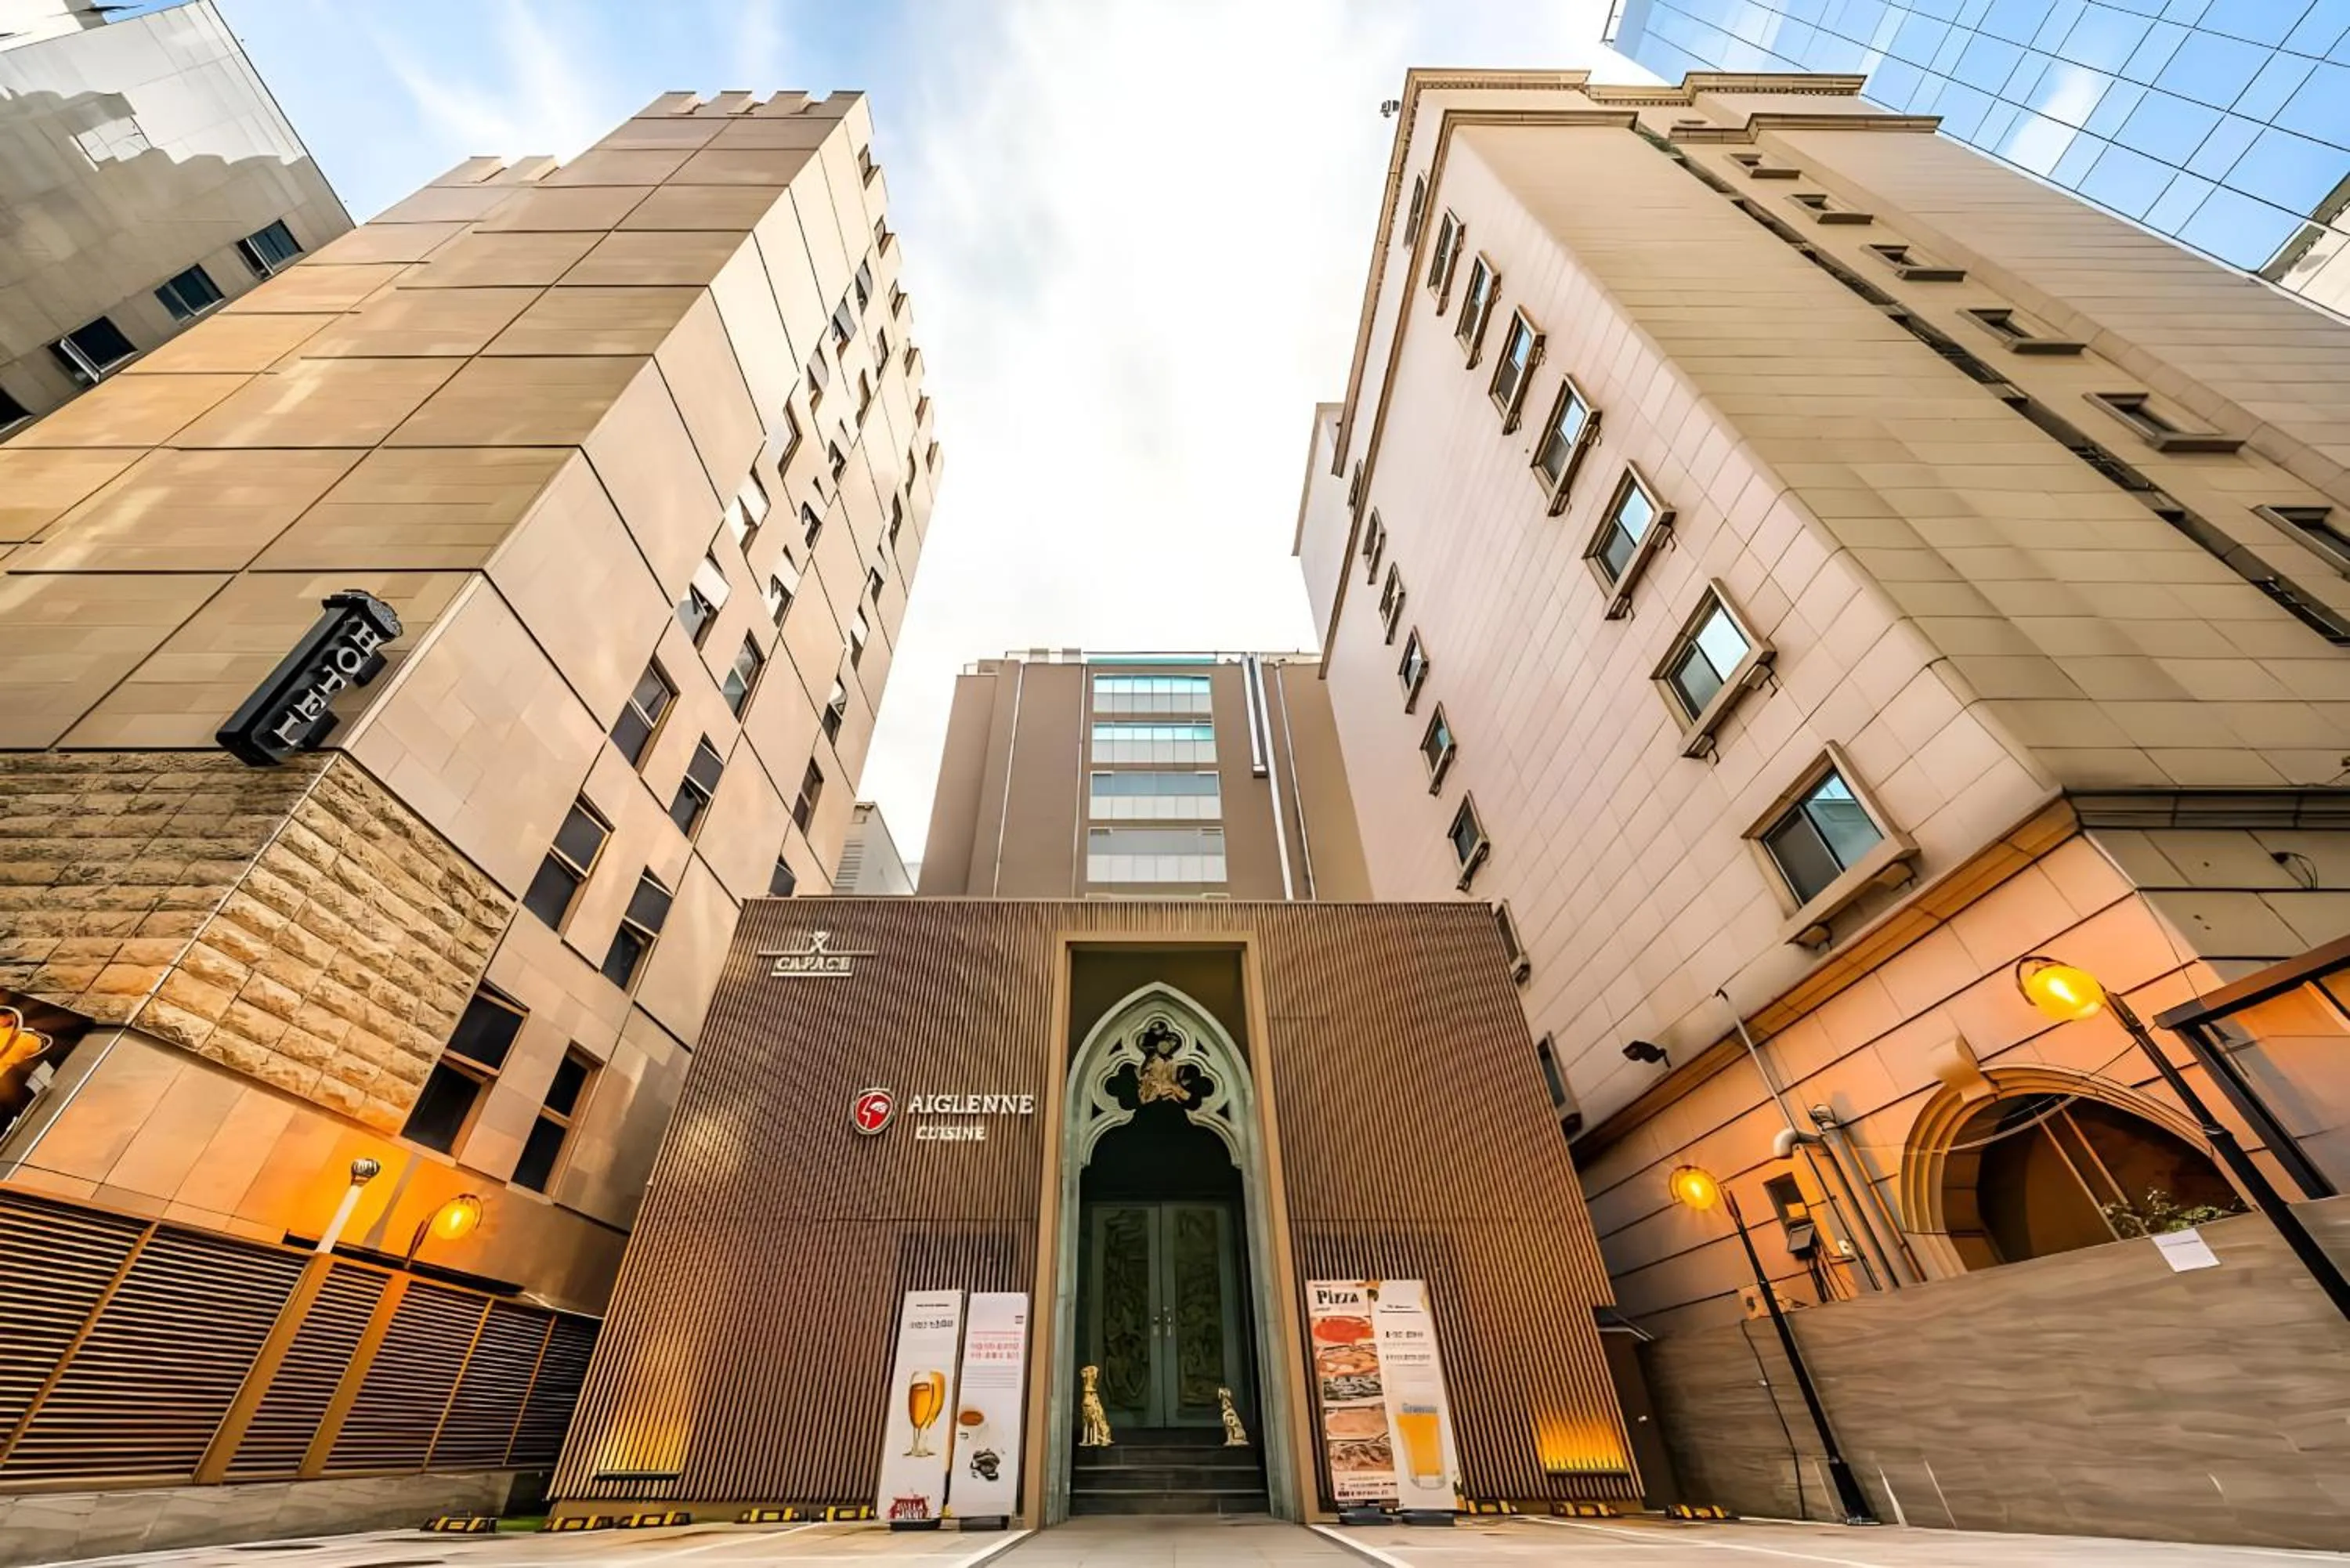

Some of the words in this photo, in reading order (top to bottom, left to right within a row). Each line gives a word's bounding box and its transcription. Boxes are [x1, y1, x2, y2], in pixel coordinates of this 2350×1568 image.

[273, 619, 383, 746] HOTEL
[907, 1094, 1034, 1115] AIGLENNE
[915, 1125, 985, 1140] CUISINE
